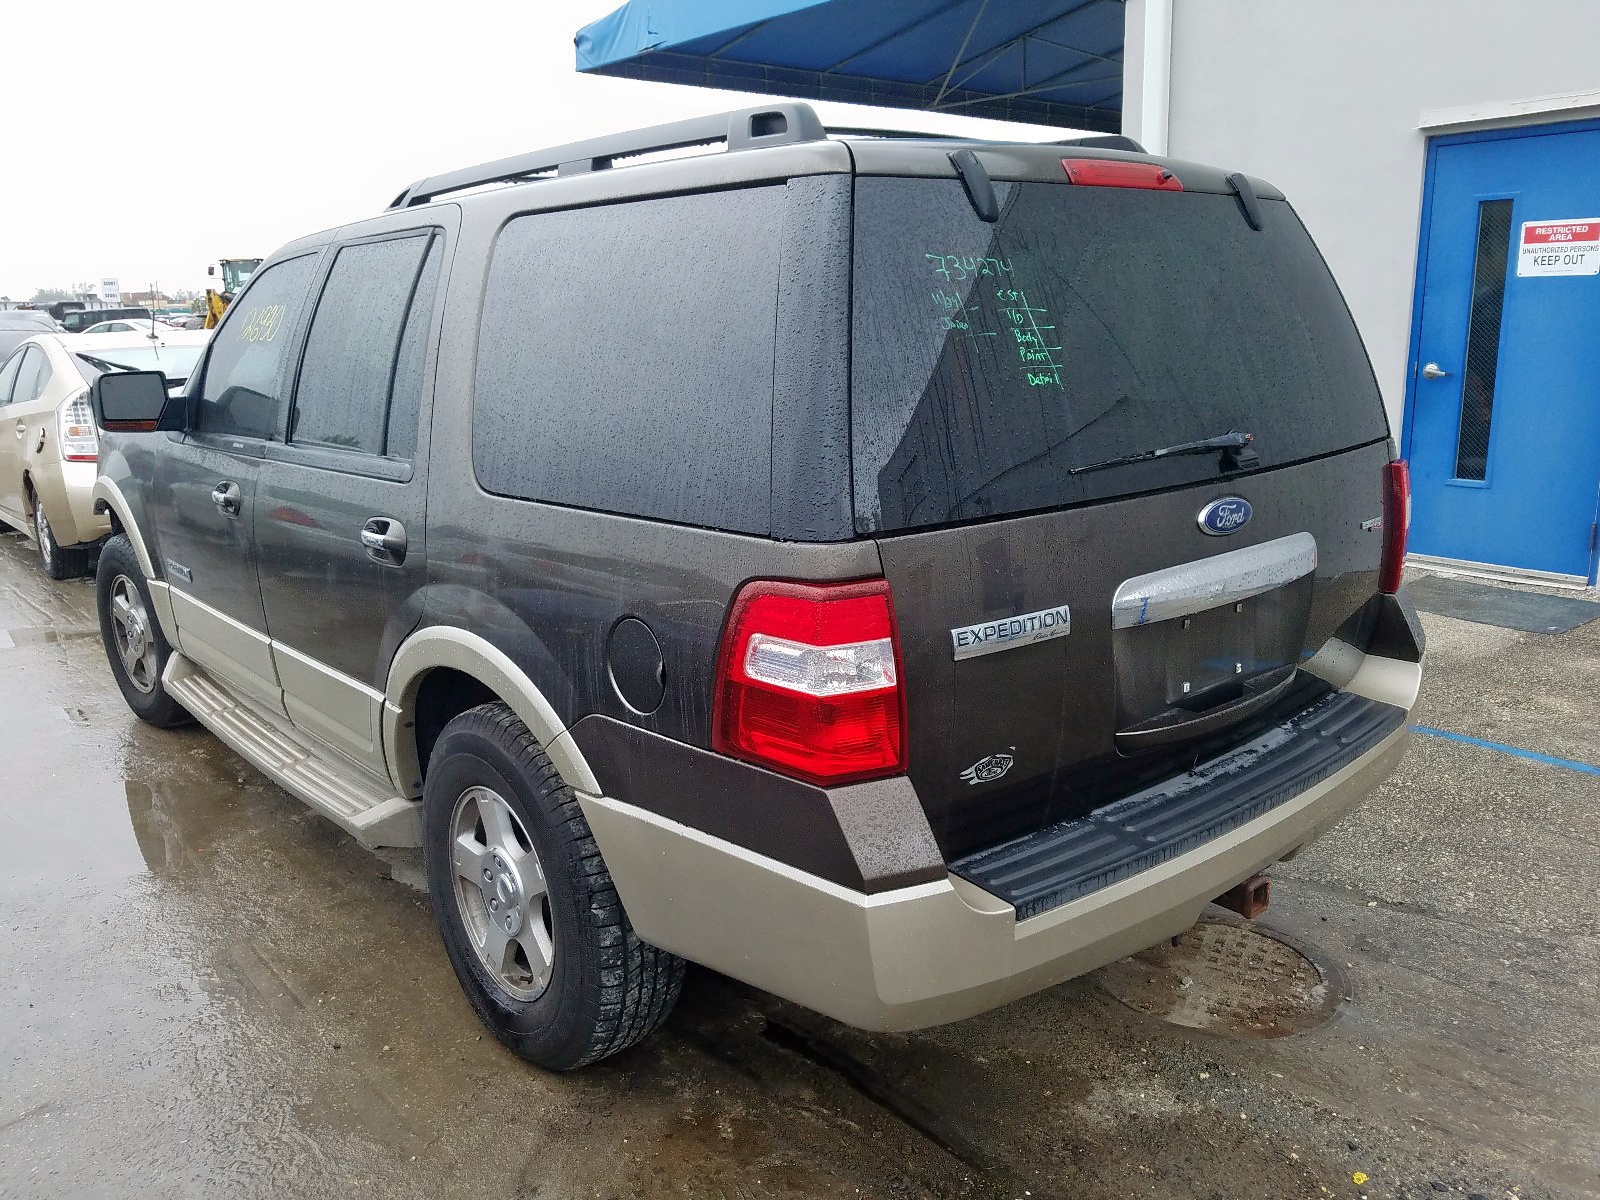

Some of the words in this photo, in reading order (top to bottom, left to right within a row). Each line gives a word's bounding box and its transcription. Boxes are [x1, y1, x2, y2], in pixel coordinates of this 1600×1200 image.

[1535, 225, 1589, 235] RESTRICTED
[1549, 233, 1573, 241] AREA
[1522, 246, 1569, 255] UNAUTHORIZED
[1569, 244, 1600, 253] PERSONS
[925, 253, 1015, 282] 734274
[1533, 255, 1561, 266] KEEP
[1563, 254, 1586, 265] OUT
[1013, 328, 1040, 351] Body
[1216, 503, 1245, 528] Ford
[956, 609, 1069, 647] EXPEDITION
